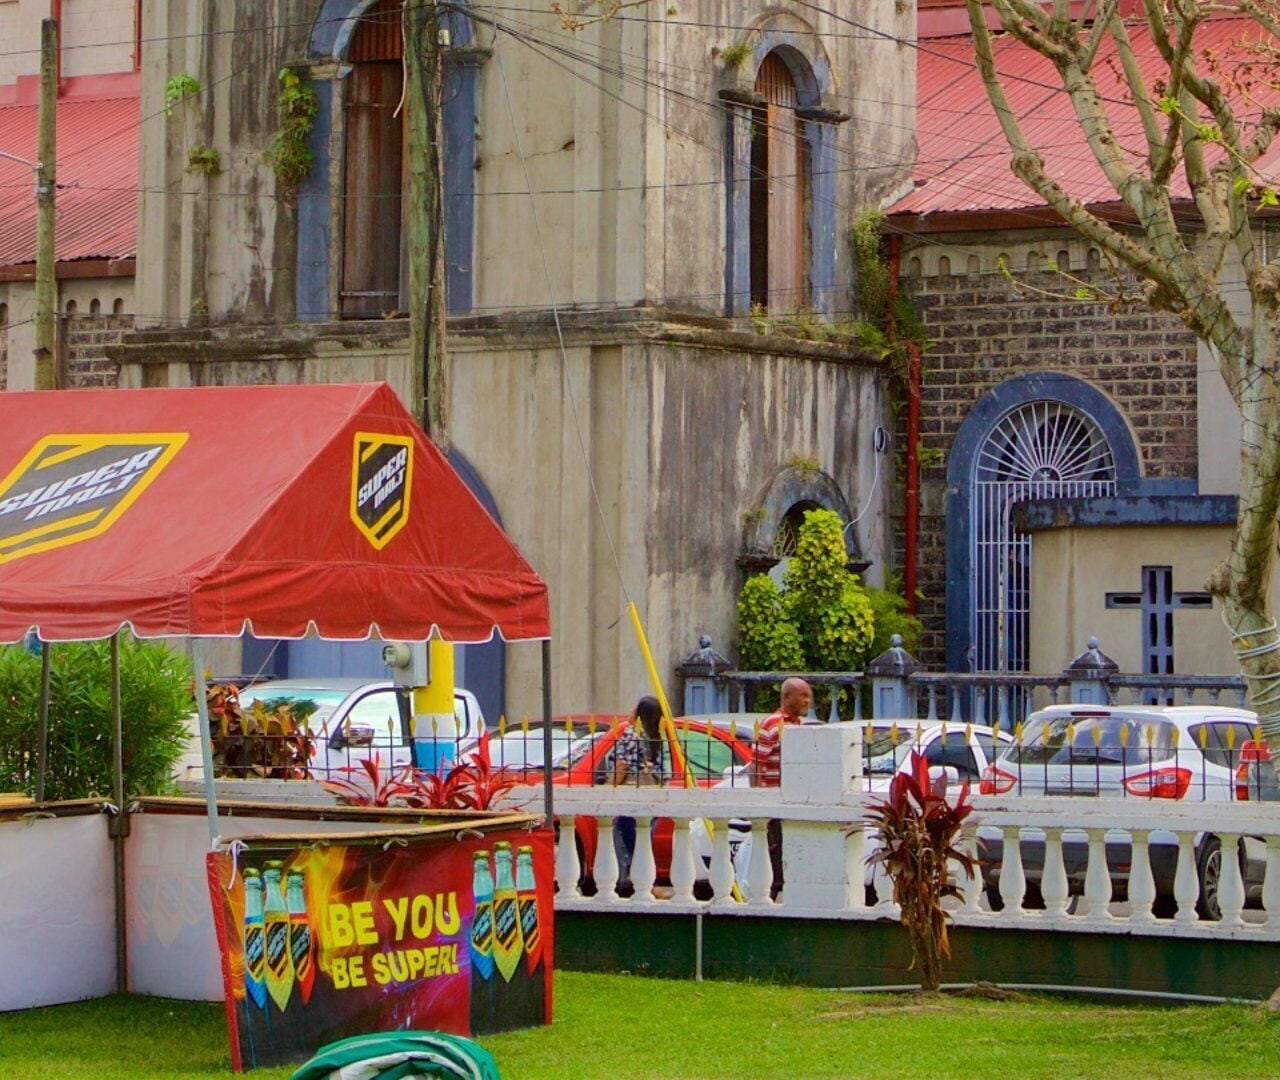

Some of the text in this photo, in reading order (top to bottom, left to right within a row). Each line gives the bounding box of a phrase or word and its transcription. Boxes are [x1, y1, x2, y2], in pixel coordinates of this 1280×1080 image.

[24, 470, 145, 521] MALT
[358, 447, 407, 508] SUPER
[374, 466, 406, 509] MALT
[328, 901, 379, 948] BE
[382, 891, 460, 941] YOU
[331, 943, 459, 990] BE SUPER!
